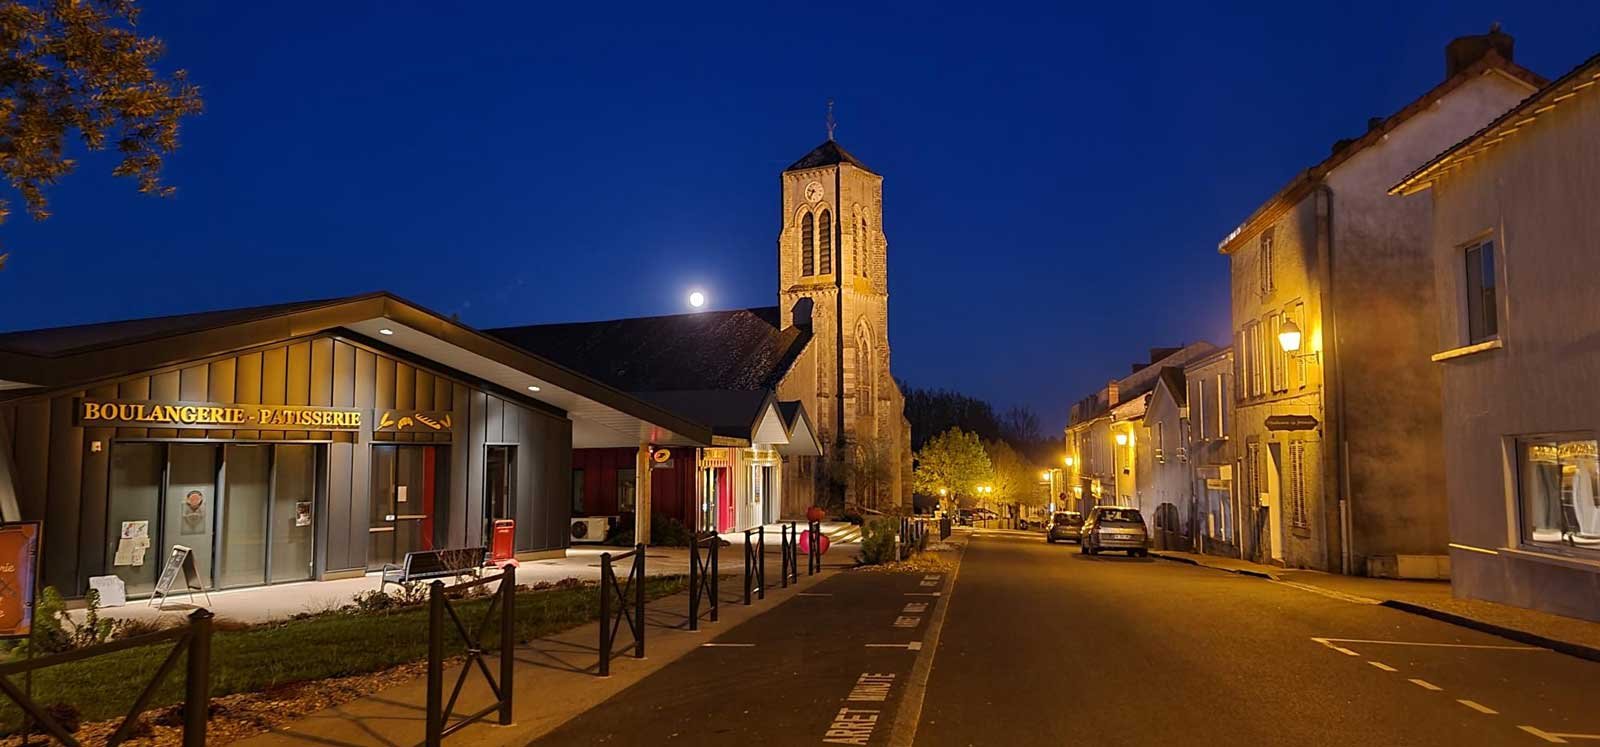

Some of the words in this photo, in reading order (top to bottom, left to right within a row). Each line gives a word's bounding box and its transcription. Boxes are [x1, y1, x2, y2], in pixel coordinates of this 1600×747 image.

[83, 402, 245, 424] BOULANGERIE
[260, 408, 361, 427] PATISSERIE
[846, 672, 896, 701] MINUTE
[822, 707, 880, 746] ARRET
